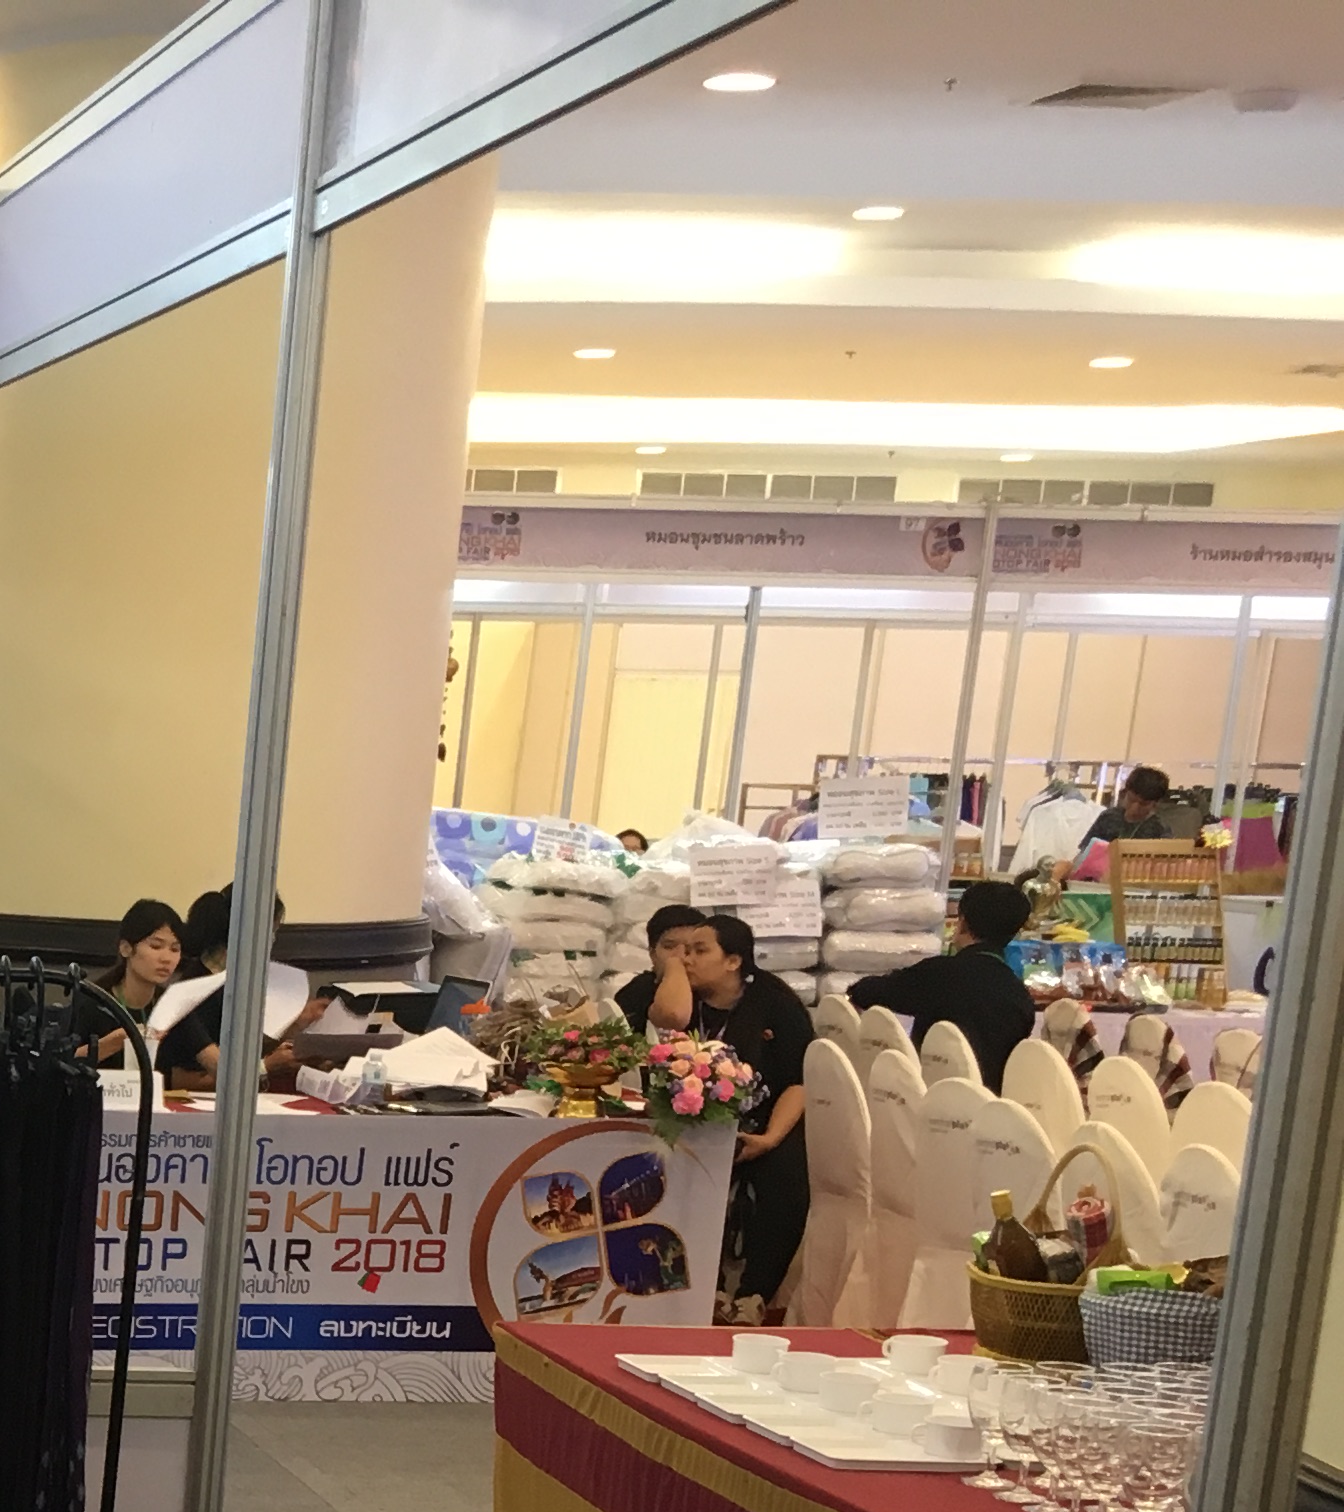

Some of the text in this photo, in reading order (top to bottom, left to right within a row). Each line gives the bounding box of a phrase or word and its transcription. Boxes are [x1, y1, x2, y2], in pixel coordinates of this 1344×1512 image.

[256, 1137, 365, 1187] โอทอป
[383, 1142, 460, 1187] แฟร์
[284, 1190, 453, 1235] KHAI
[95, 1237, 446, 1274] TOP AIR 2018
[318, 1313, 451, 1340] ลงทะเบียน
